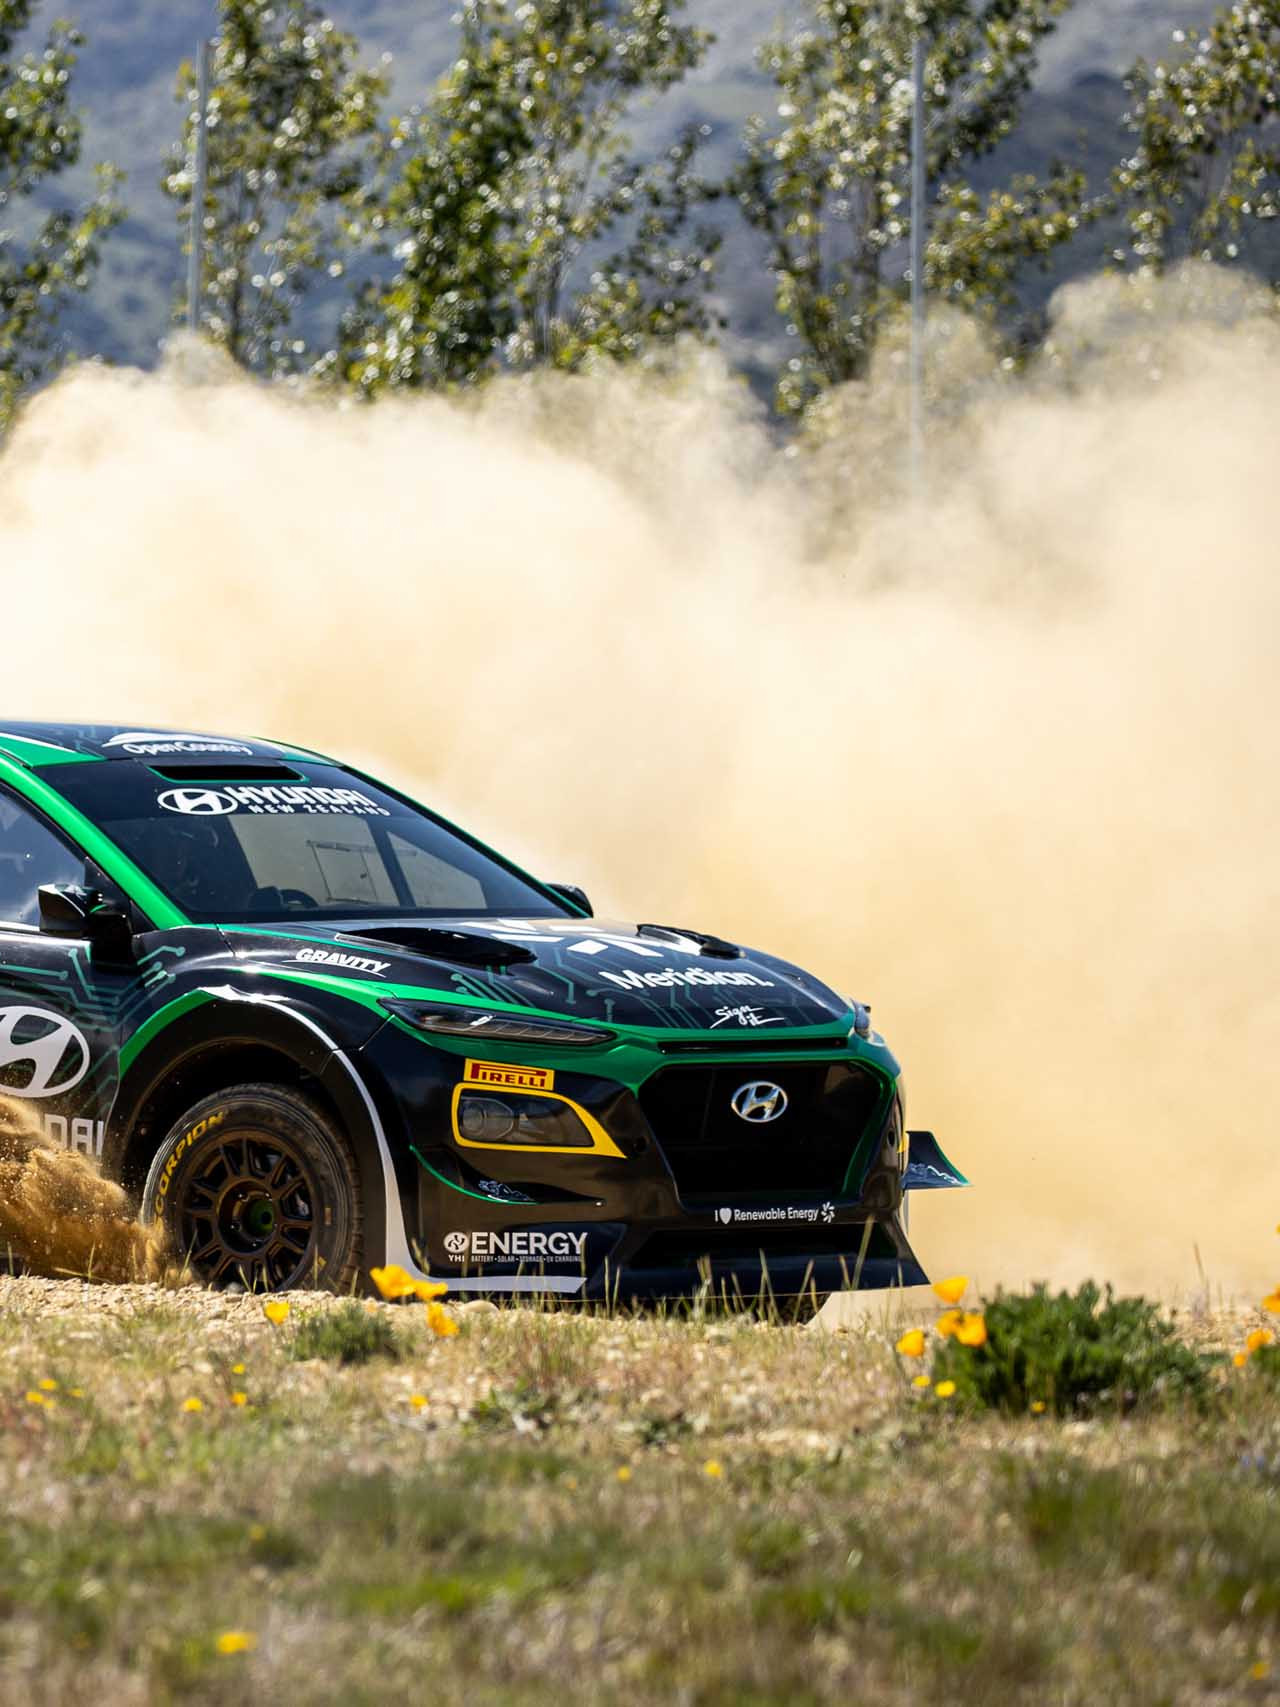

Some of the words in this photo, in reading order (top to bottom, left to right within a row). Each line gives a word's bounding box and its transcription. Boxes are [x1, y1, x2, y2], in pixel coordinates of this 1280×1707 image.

[224, 786, 377, 807] HYUNDAI
[248, 804, 296, 813] NEW
[303, 804, 391, 816] ZEALAND
[296, 948, 391, 972] GRAVITY
[711, 1005, 765, 1029] Sign
[470, 1063, 547, 1088] PIRELLI
[734, 1207, 786, 1221] Renewable
[787, 1207, 819, 1221] Energy
[471, 1232, 588, 1255] ENERGY
[447, 1254, 465, 1262] YHI
[471, 1255, 494, 1263] BATTERY
[497, 1255, 515, 1263] SOLAR
